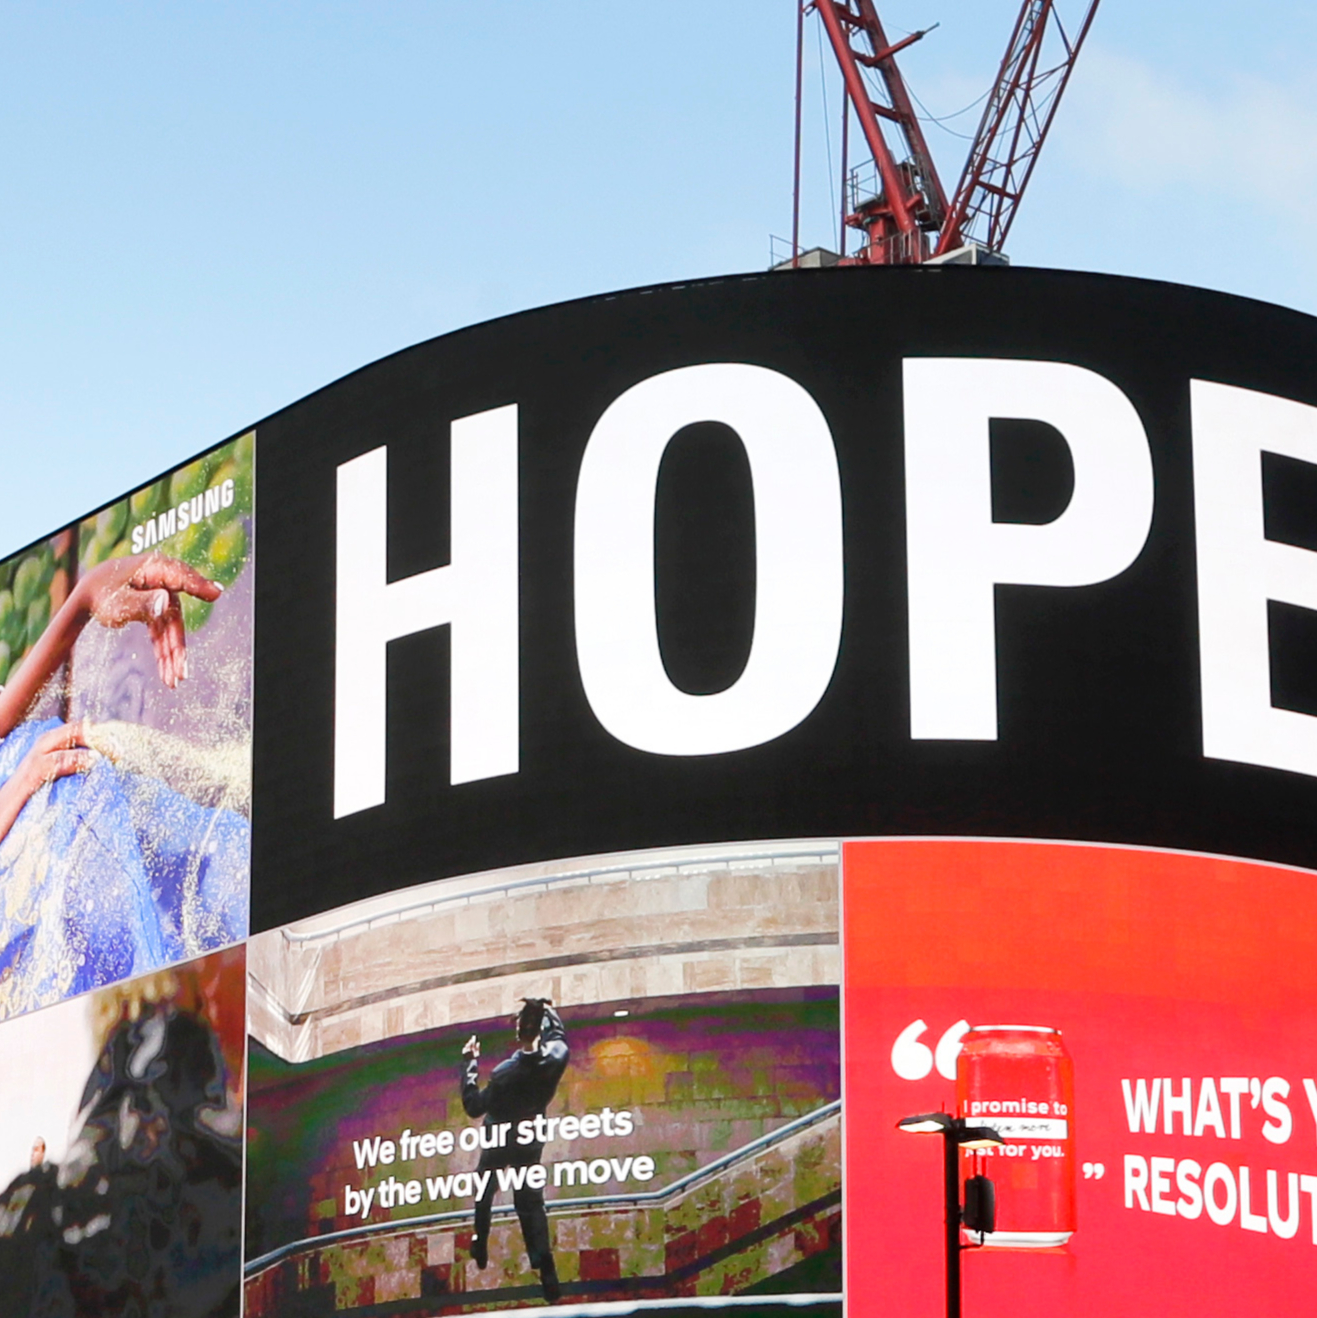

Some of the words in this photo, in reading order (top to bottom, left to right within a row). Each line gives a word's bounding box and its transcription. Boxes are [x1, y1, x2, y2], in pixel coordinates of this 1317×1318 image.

[130, 478, 235, 554] SAMSUNG
[333, 356, 1317, 819] HOPE
[352, 1136, 396, 1170] We
[400, 1127, 455, 1161] free
[459, 1121, 511, 1152] our
[516, 1107, 635, 1145] streets
[971, 1098, 1049, 1116] promise
[1053, 1101, 1068, 1116] to
[1121, 1076, 1293, 1145] WHAT'S
[998, 1144, 1027, 1157] for
[1031, 1145, 1065, 1160] you.
[344, 1184, 375, 1219] by
[378, 1176, 422, 1209] the
[426, 1168, 491, 1202] way
[495, 1163, 547, 1192] we
[553, 1154, 656, 1187] move
